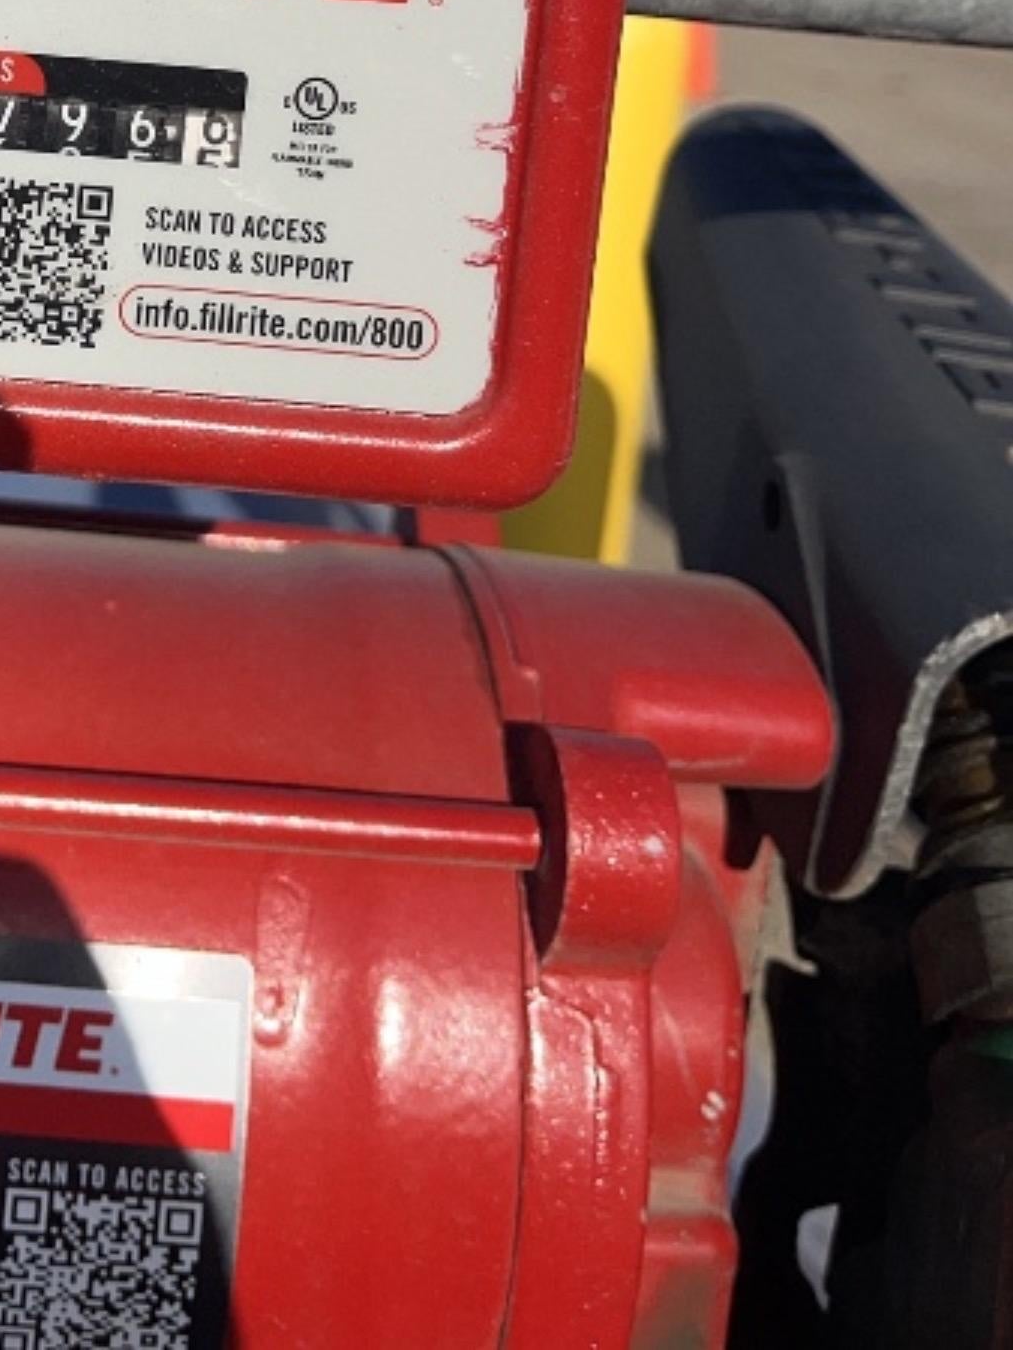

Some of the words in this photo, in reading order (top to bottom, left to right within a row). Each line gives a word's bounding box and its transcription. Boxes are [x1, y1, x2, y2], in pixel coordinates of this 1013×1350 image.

[144, 206, 201, 235] SCAN
[209, 211, 235, 236] TO
[241, 214, 328, 245] ACCESS
[141, 241, 221, 272] VIDEOS
[228, 250, 244, 275] &
[250, 250, 355, 284] SUPPORT
[134, 295, 424, 351] info.fillrite.com/800
[7, 1157, 69, 1186] SCAN
[78, 1162, 107, 1190] TO
[114, 1166, 207, 1197] ACCESS
